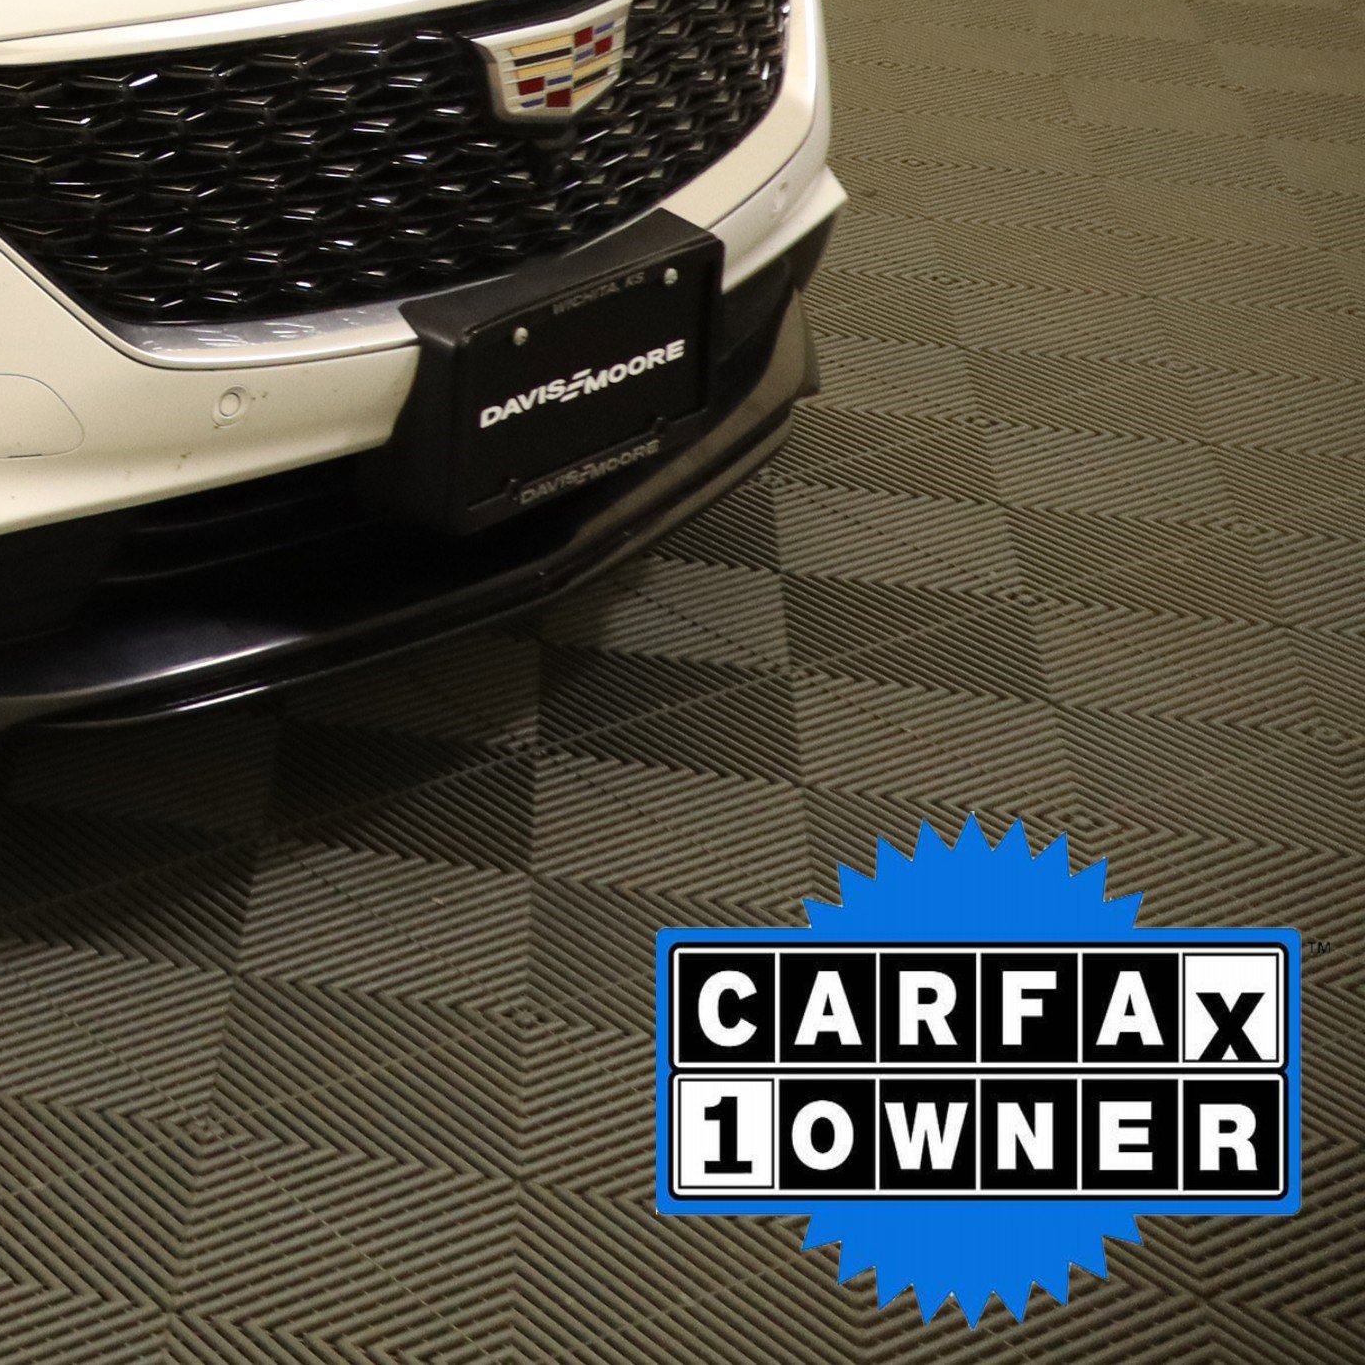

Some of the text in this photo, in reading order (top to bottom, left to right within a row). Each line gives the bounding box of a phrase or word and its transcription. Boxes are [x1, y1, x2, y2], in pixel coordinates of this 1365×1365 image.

[480, 339, 685, 428] DAVIS MOORE
[520, 438, 660, 504] DAVIS MOORE
